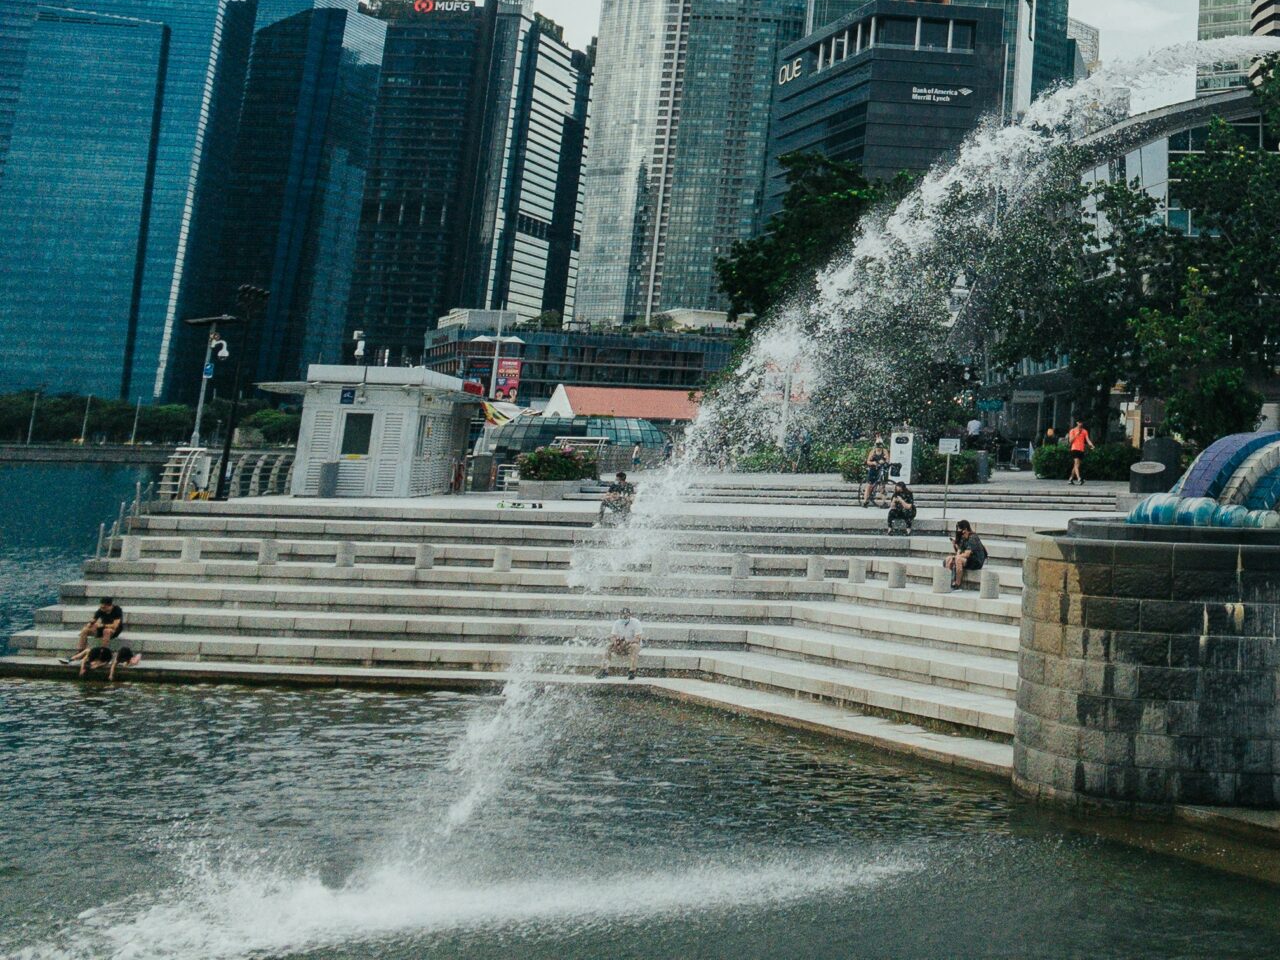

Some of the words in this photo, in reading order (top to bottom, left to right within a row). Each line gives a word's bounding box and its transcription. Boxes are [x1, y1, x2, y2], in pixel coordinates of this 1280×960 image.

[434, 1, 471, 12] MUFG
[778, 57, 803, 86] OUE
[912, 86, 927, 94] Bank
[934, 88, 958, 96] America
[911, 93, 932, 101] Merrill
